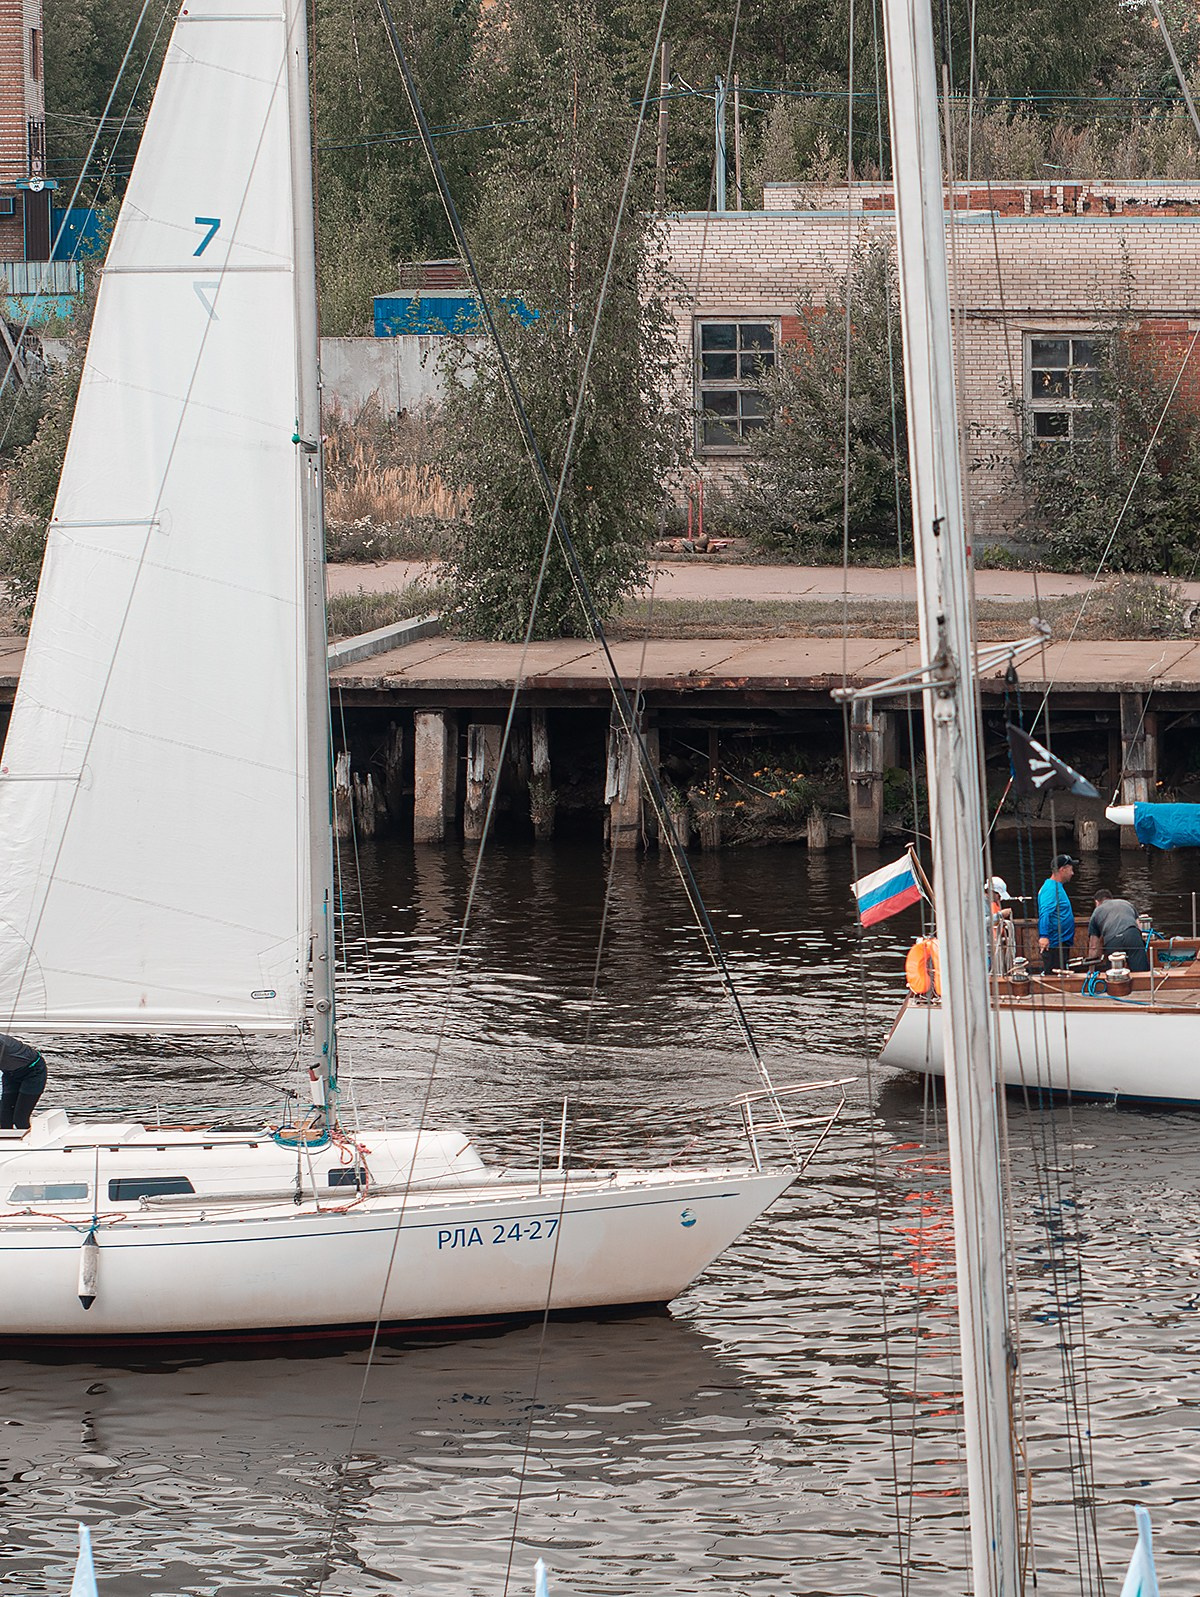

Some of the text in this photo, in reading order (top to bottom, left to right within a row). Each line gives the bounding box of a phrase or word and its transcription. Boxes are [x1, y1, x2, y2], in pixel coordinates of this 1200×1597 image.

[193, 216, 220, 256] 7
[438, 1219, 559, 1250] РЛА 24-27
